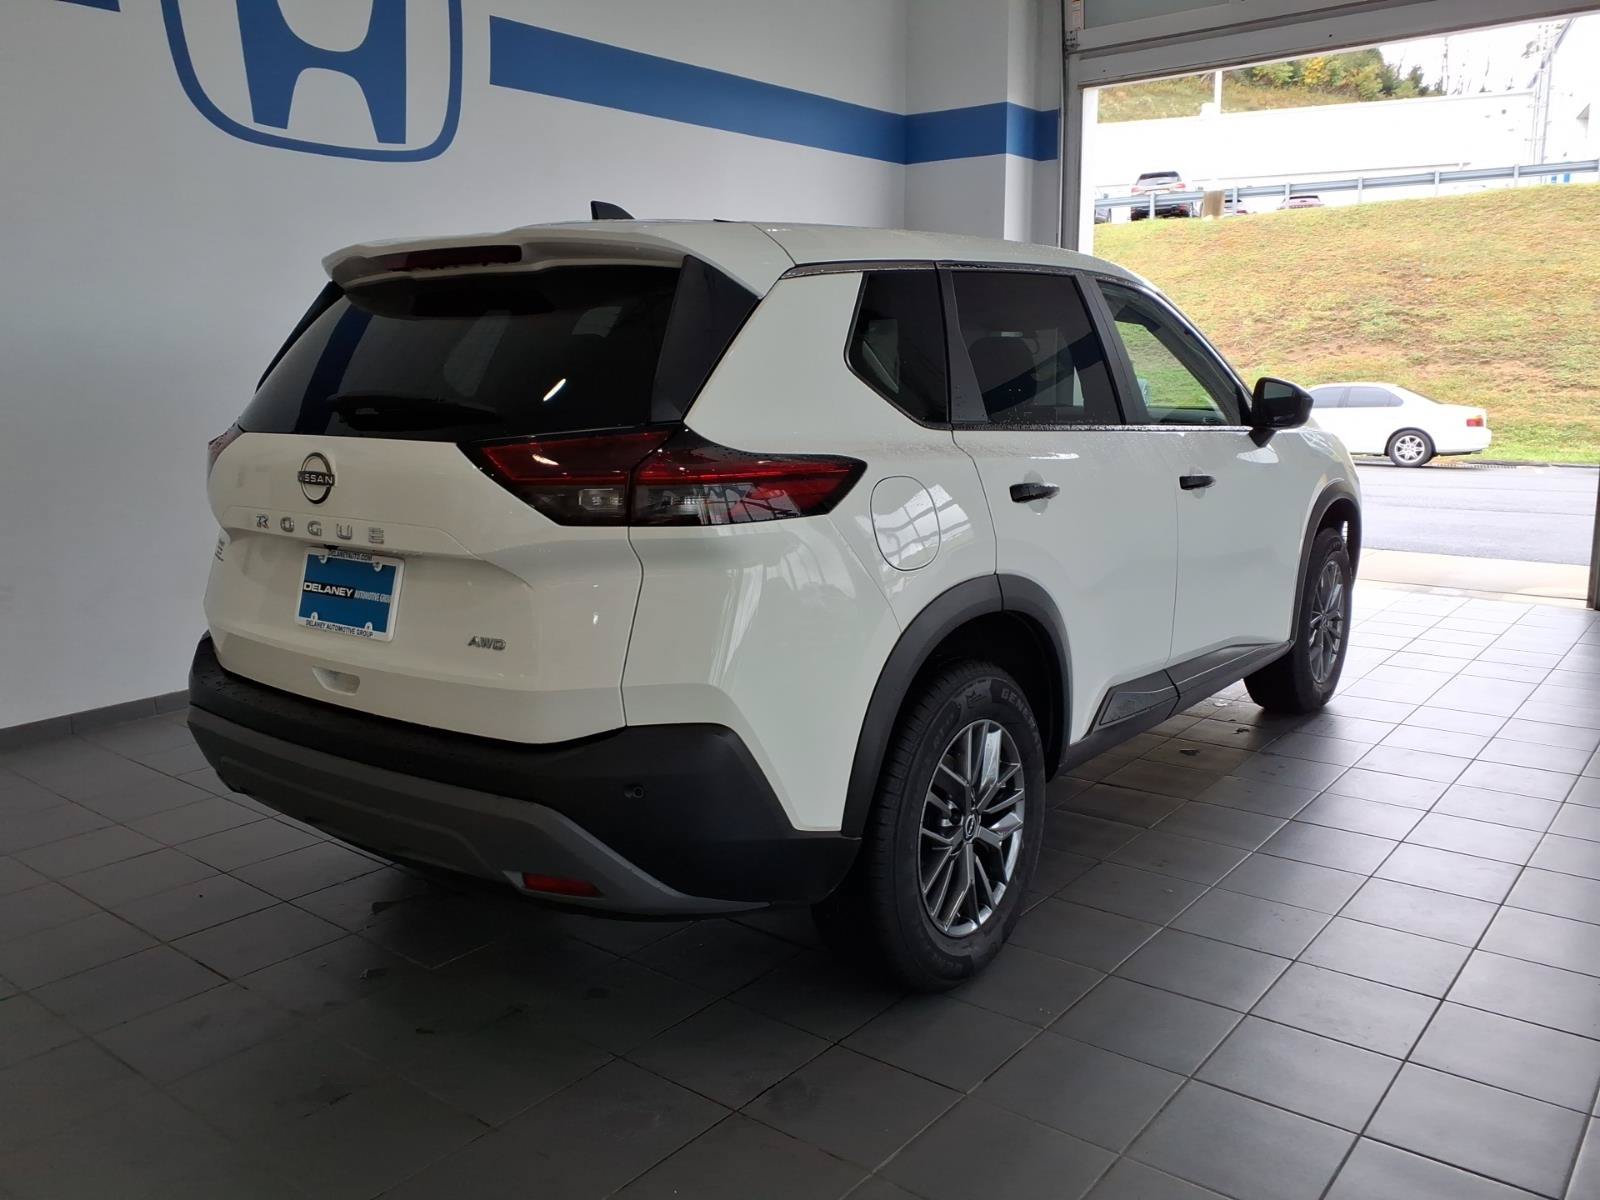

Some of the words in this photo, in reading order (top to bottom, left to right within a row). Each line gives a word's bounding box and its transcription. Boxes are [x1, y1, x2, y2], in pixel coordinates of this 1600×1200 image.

[298, 472, 334, 484] NISSAN
[256, 514, 384, 544] ROGUE
[303, 582, 353, 597] DELANEY
[305, 620, 325, 630] DELANEY
[326, 623, 355, 634] AUTOMOTIVE
[356, 628, 374, 638] GROUP
[467, 635, 507, 651] AWD
